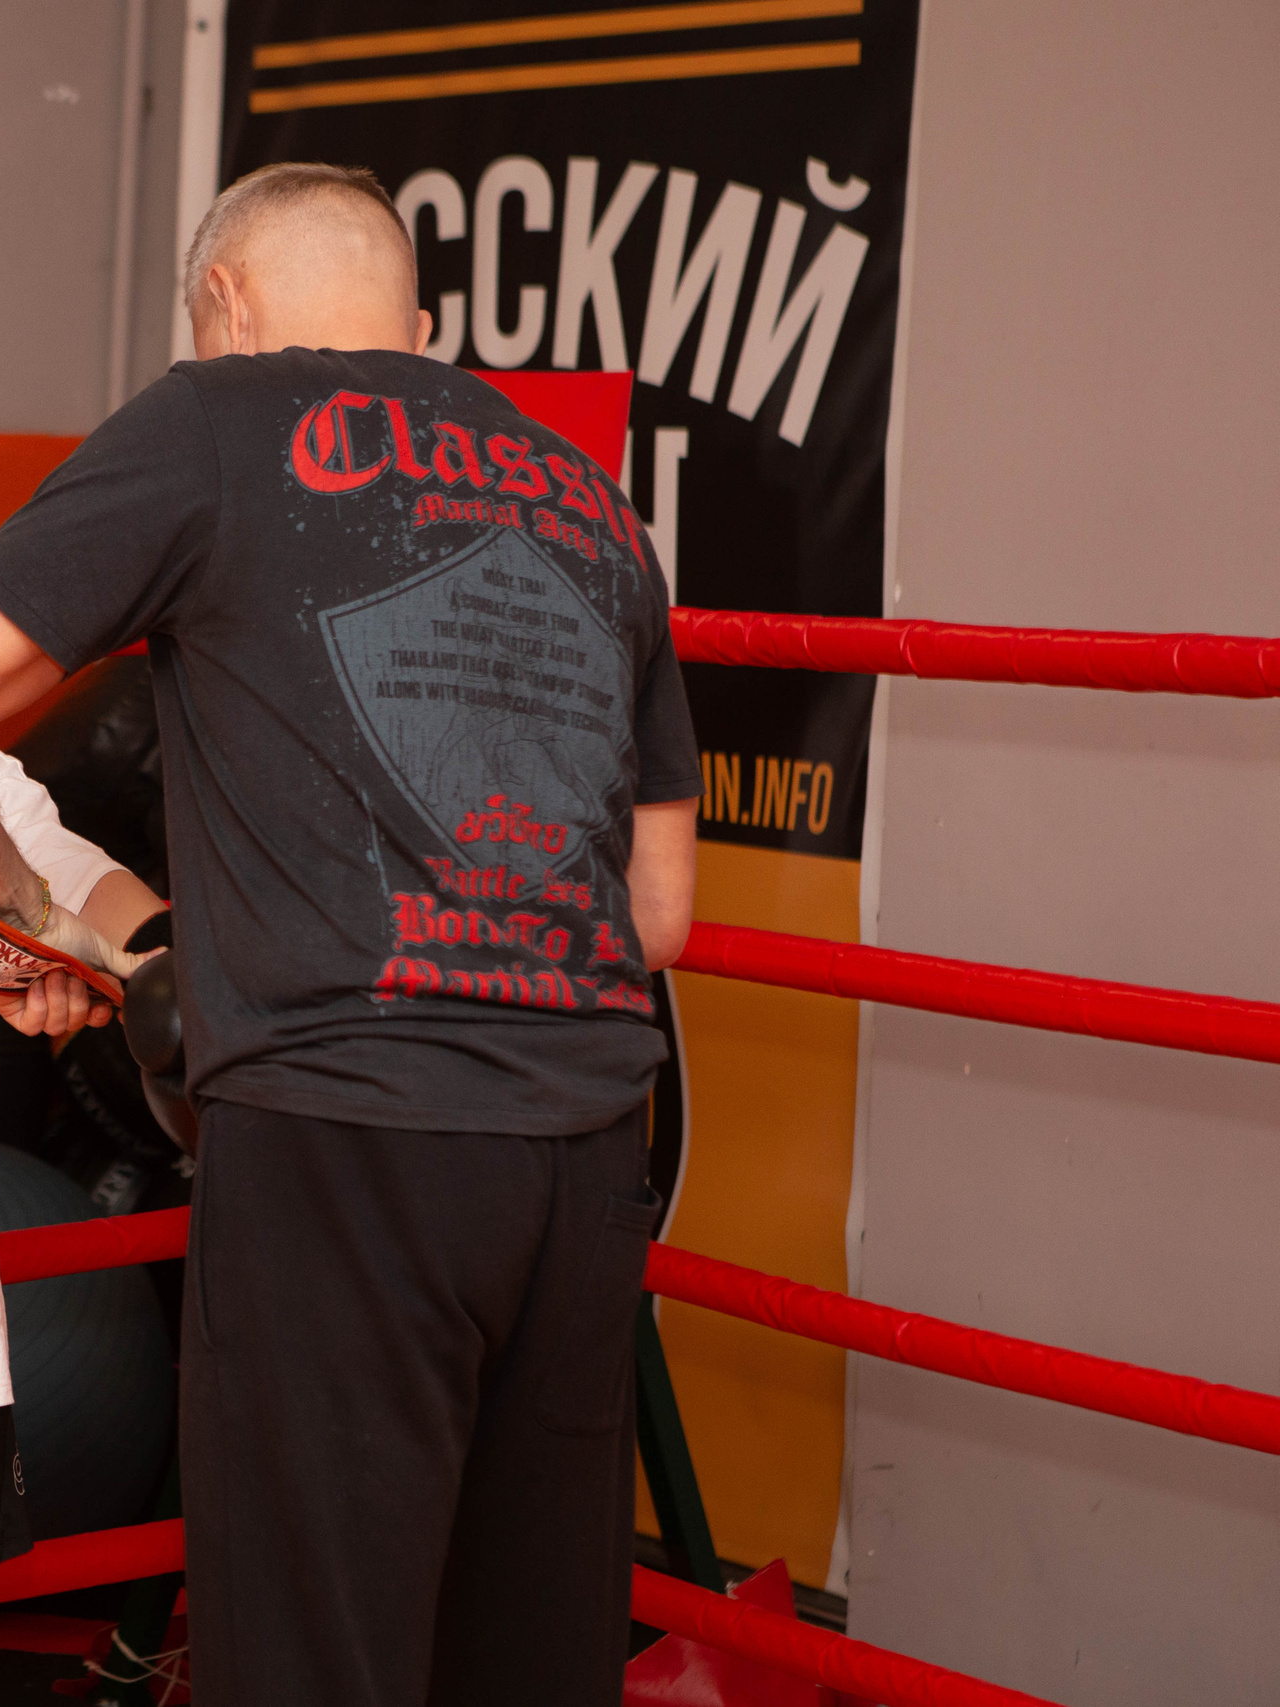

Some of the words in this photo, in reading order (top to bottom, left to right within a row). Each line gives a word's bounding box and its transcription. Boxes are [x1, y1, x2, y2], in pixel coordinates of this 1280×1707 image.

[397, 155, 870, 447] ССКИЙ
[413, 494, 523, 529] Martial
[534, 508, 599, 561] Arts
[694, 751, 834, 835] IN.INFO
[372, 956, 578, 1010] Martial
